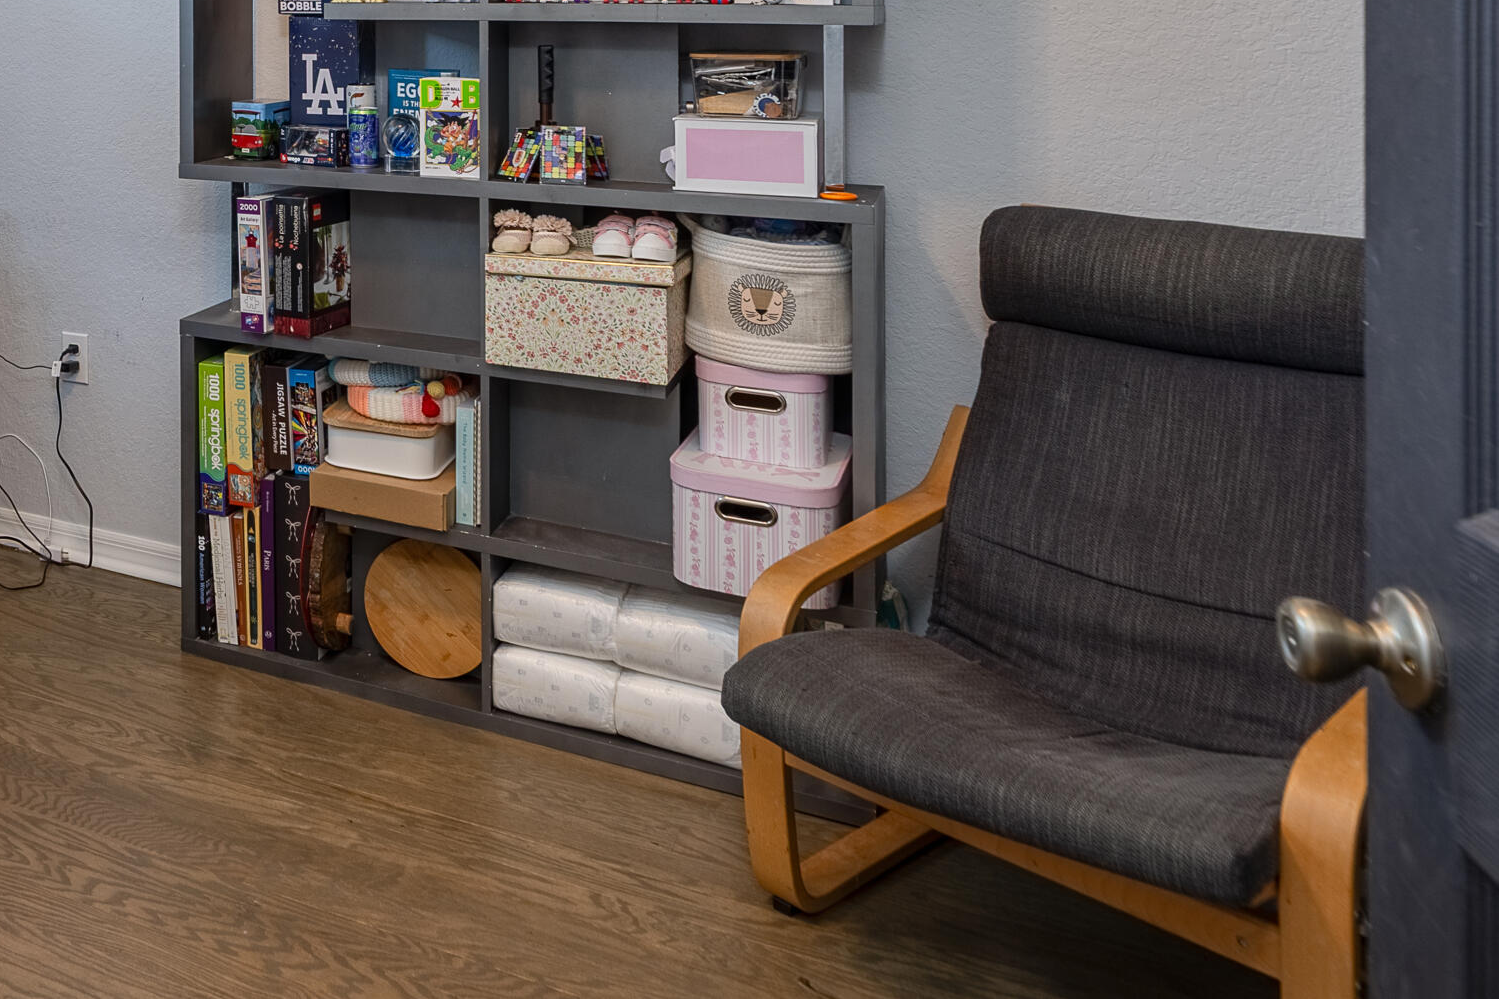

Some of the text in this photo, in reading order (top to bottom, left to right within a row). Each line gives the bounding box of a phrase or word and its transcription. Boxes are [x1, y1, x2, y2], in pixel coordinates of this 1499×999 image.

[280, 1, 322, 11] BOBBLE
[302, 53, 344, 115] LA
[393, 108, 420, 119] ENEM
[240, 203, 258, 211] 2000
[208, 373, 223, 471] 1000 springbok
[234, 363, 250, 460] 1000 springbok
[276, 382, 288, 456] JIGSAW PUZZLE
[198, 535, 206, 551] 100
